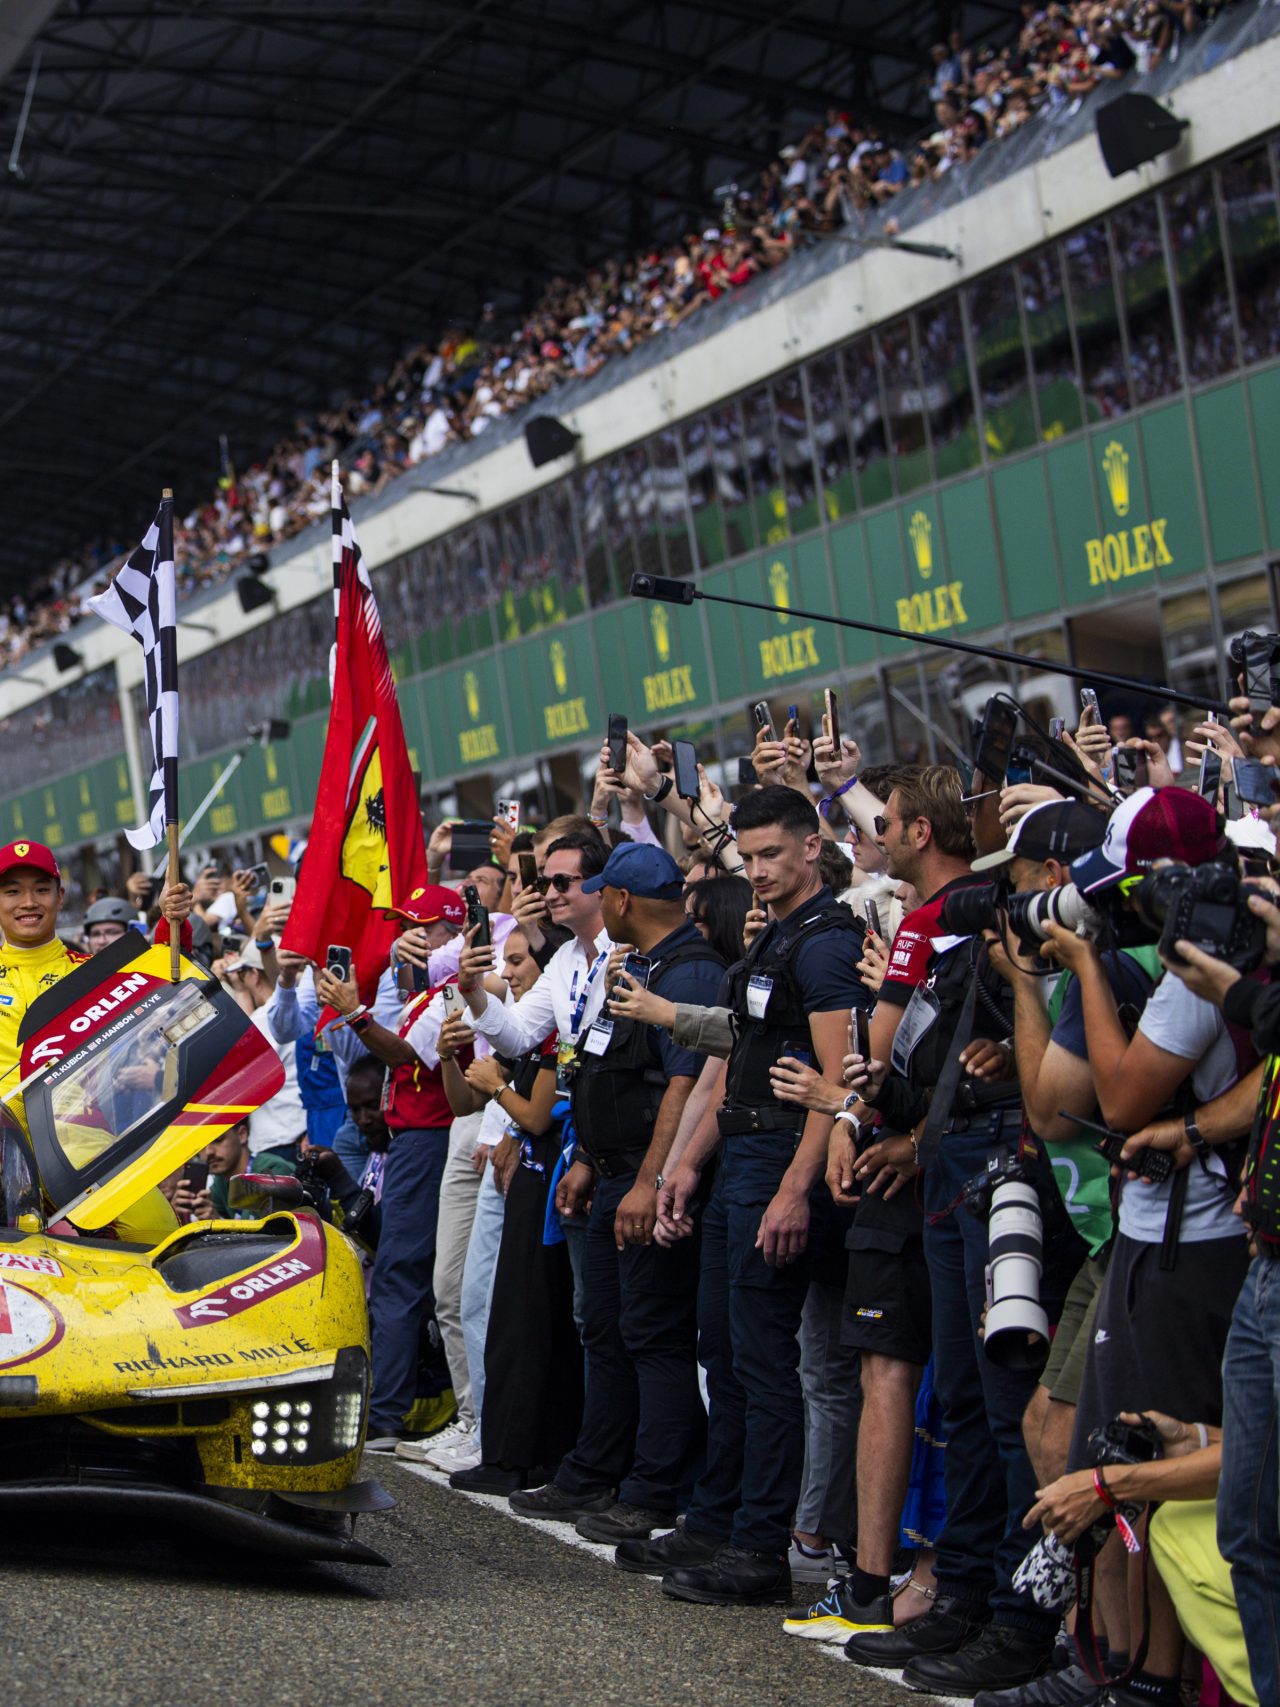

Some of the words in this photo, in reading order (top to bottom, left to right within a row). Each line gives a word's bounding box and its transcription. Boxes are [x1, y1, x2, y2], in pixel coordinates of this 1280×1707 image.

[1085, 518, 1174, 586] ROLEX
[896, 581, 968, 639] ROLEX
[759, 626, 819, 679] ROLEX
[643, 664, 696, 712] ROLEX
[896, 939, 914, 951] RUF
[69, 972, 149, 1033] ORLEN
[52, 1070, 61, 1079] R.
[60, 1050, 88, 1073] KUBICA
[96, 1037, 105, 1045] P.
[103, 1013, 135, 1039] HANSON
[142, 1001, 151, 1009] Y.
[150, 993, 162, 1005] YE
[230, 1258, 312, 1300] ORLEN
[113, 1352, 234, 1373] RICHARD
[238, 1337, 316, 1362] MILLE
